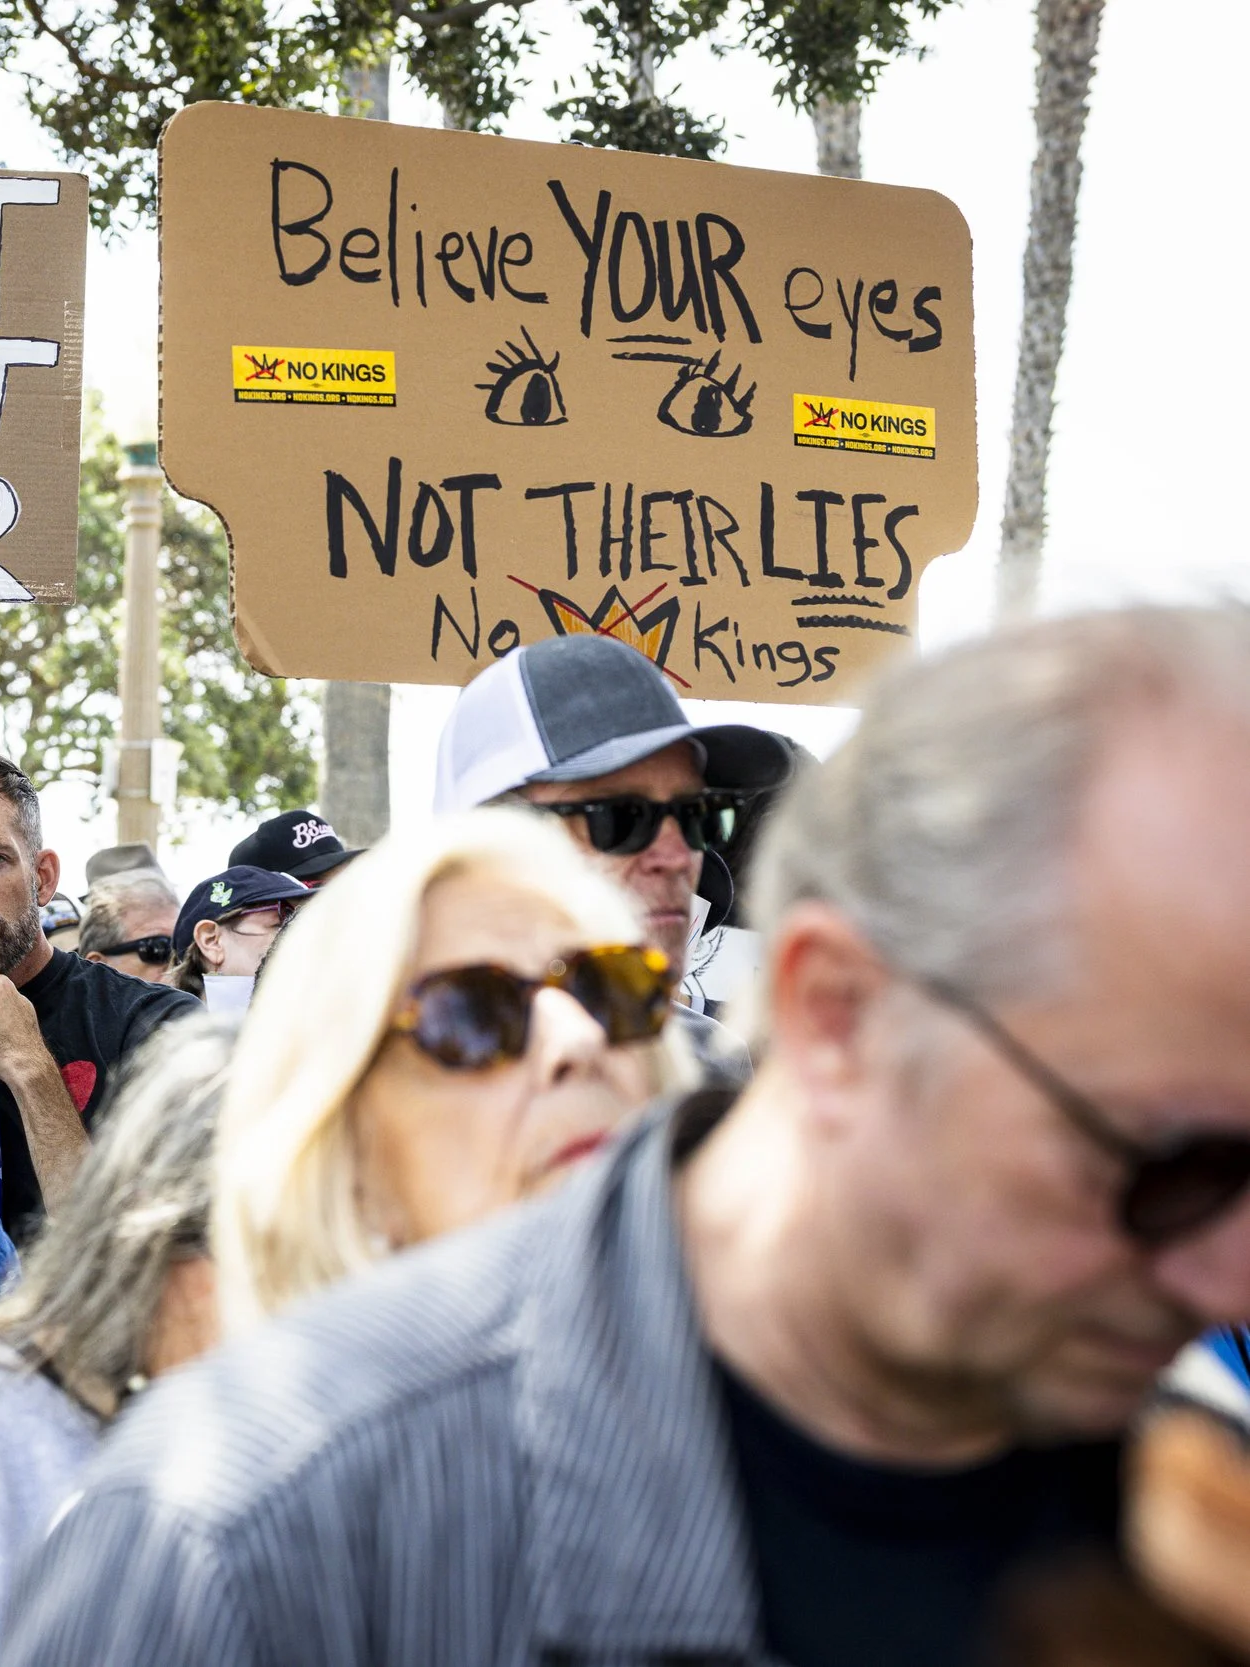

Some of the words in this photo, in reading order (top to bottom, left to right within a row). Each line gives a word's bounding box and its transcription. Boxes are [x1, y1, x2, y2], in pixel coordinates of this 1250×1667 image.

[270, 157, 550, 308] Believe
[547, 178, 763, 345] YOUR
[784, 267, 943, 382] eyes
[287, 361, 318, 380] NO
[321, 362, 386, 383] KINGS
[840, 411, 868, 430] NO
[870, 414, 927, 436] KINGS
[324, 456, 502, 580] NOT
[524, 481, 751, 588] THEIR
[758, 481, 920, 602] LIES
[431, 585, 521, 662] No
